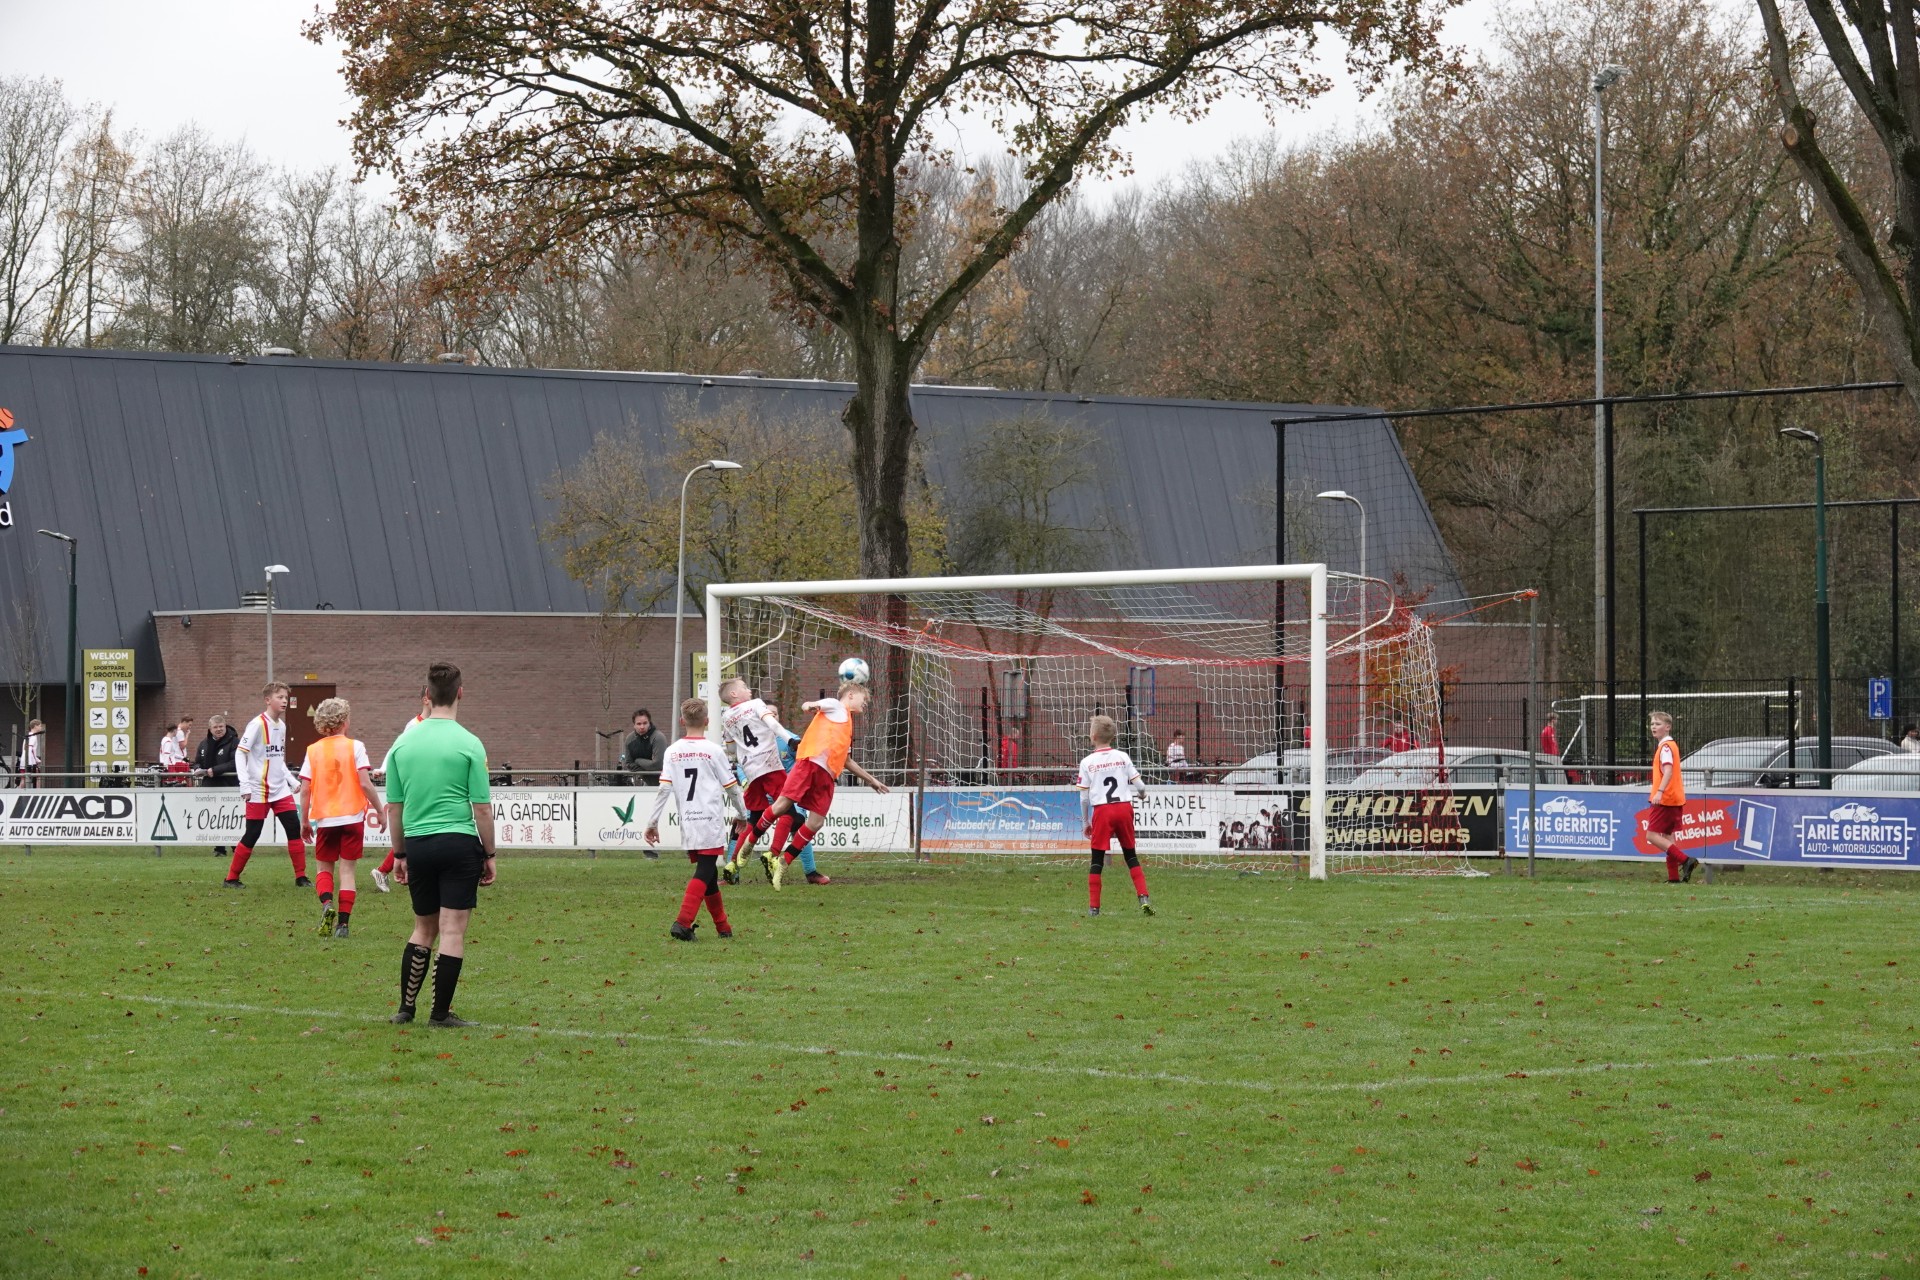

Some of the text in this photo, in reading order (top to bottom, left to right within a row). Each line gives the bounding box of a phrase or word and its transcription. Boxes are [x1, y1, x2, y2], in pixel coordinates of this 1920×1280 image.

[90, 652, 129, 660] WELKOM
[1874, 682, 1886, 703] P
[742, 724, 759, 748] 4
[684, 767, 698, 801] 7
[1103, 776, 1121, 803] 2
[53, 795, 133, 819] ACD
[1131, 795, 1207, 809] EHANDEL
[1296, 796, 1494, 816] SCHOLTEN
[197, 805, 246, 829] Oelnbr
[510, 803, 571, 821] GARDEN
[1134, 812, 1193, 827] RIK PAT
[1697, 809, 1725, 823] NAAR
[9, 826, 34, 836] AUTO
[36, 826, 81, 837] CENTRUM
[83, 826, 114, 837] DALEN
[116, 826, 133, 837] B.V.
[944, 819, 995, 832] Autobedrijf
[998, 819, 1025, 830] Peter
[1521, 816, 1609, 833] ARIE GERRITS
[1674, 825, 1723, 841] RIJBEWIJS
[1743, 807, 1763, 850] L
[1807, 824, 1903, 842] ARIE GERRITS
[830, 832, 847, 846] 36
[852, 832, 860, 846] 4
[1545, 834, 1608, 846] MOTORRIJSCHOOL
[1807, 843, 1903, 854] AUTO- MOTORRIJSCHOOL
